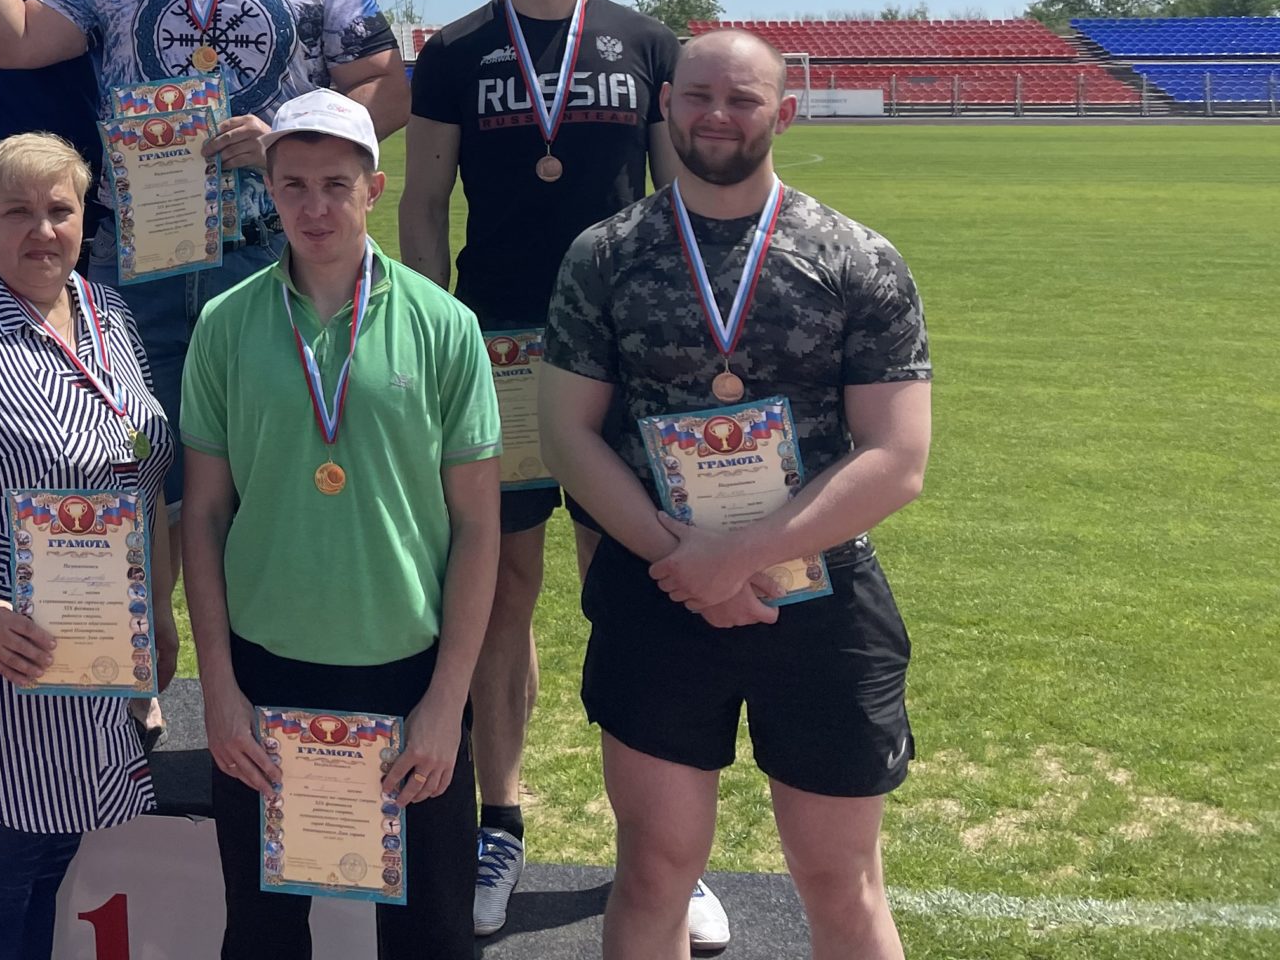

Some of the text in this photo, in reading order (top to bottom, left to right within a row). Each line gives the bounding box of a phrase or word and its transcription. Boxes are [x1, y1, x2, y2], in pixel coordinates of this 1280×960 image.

[480, 54, 518, 67] FORWAR
[477, 71, 638, 115] RUSSIA
[481, 112, 573, 130] RUSSN
[137, 148, 192, 163] ГРАМОТА
[493, 367, 533, 378] АМОТА
[696, 454, 764, 471] ГРАМОТА
[47, 538, 111, 549] ГРАМОТА
[296, 745, 364, 760] ГРАМОТА
